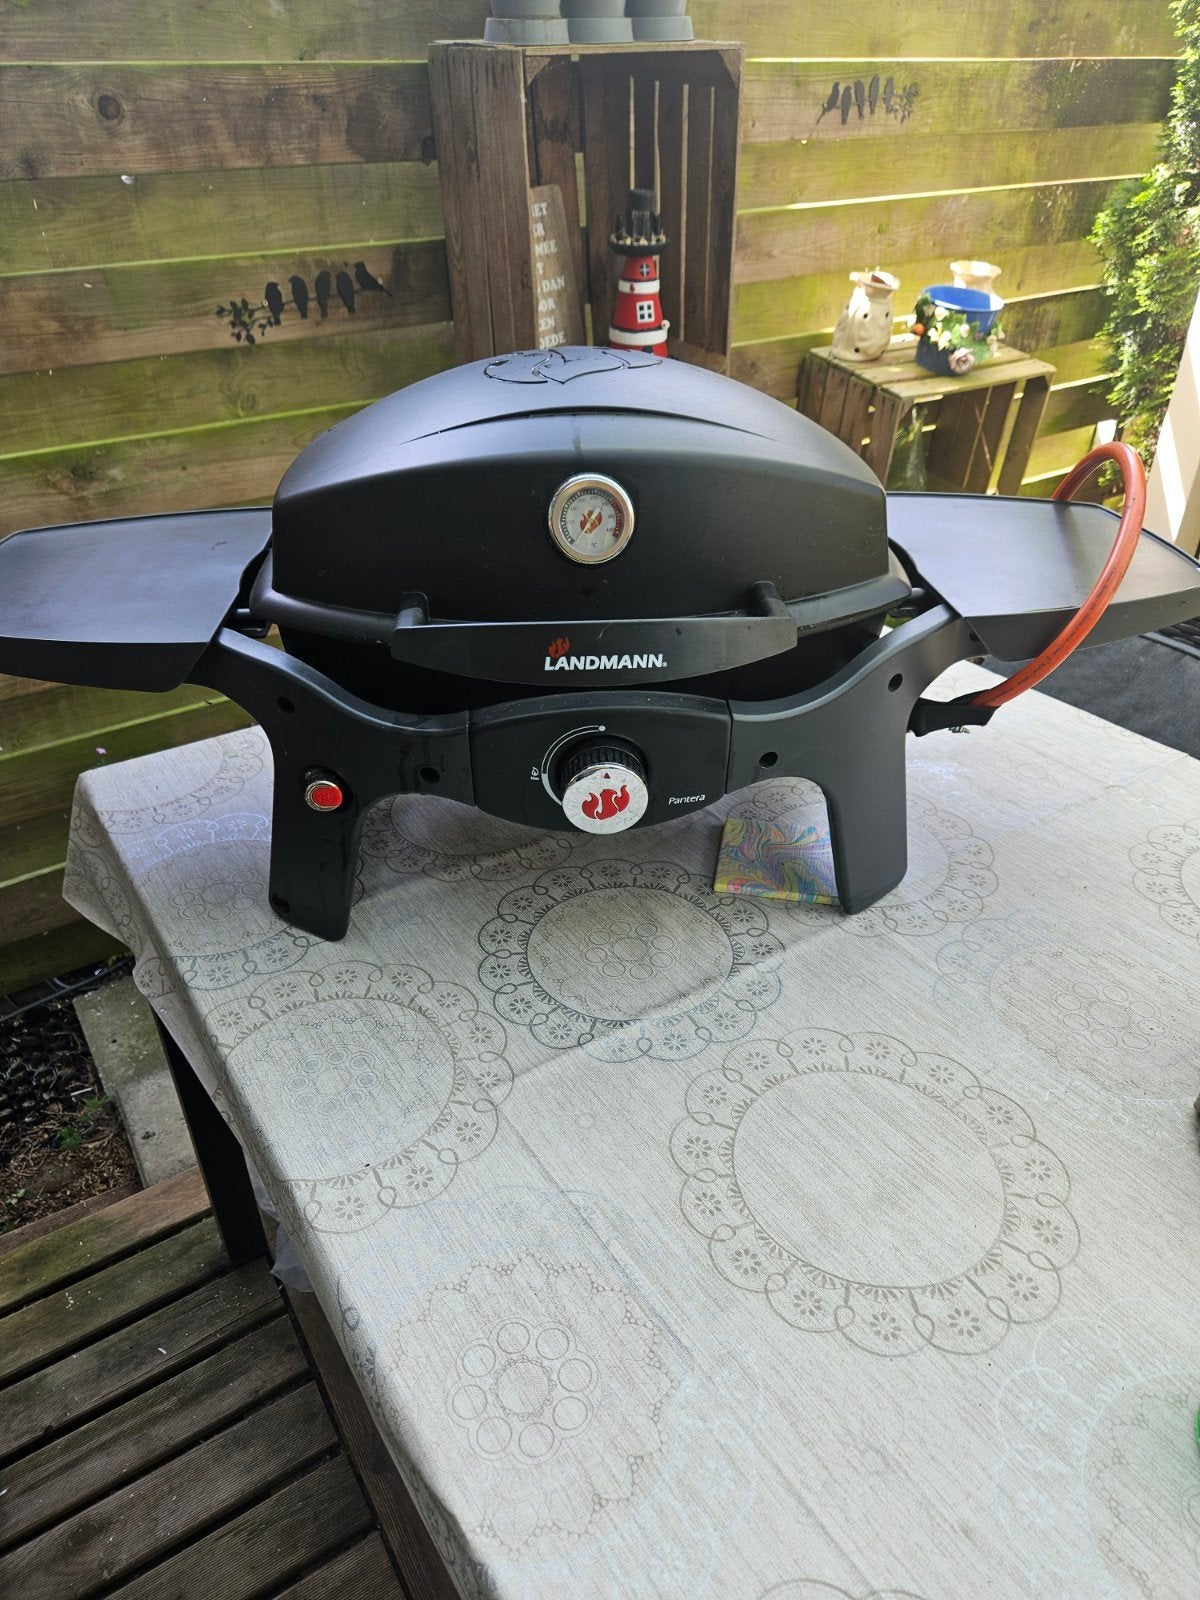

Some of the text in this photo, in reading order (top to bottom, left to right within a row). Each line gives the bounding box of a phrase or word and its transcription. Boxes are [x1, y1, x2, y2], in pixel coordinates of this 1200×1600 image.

[542, 275, 565, 293] DAN
[544, 653, 663, 671] LANDMANN
[668, 794, 706, 805] Pantera
